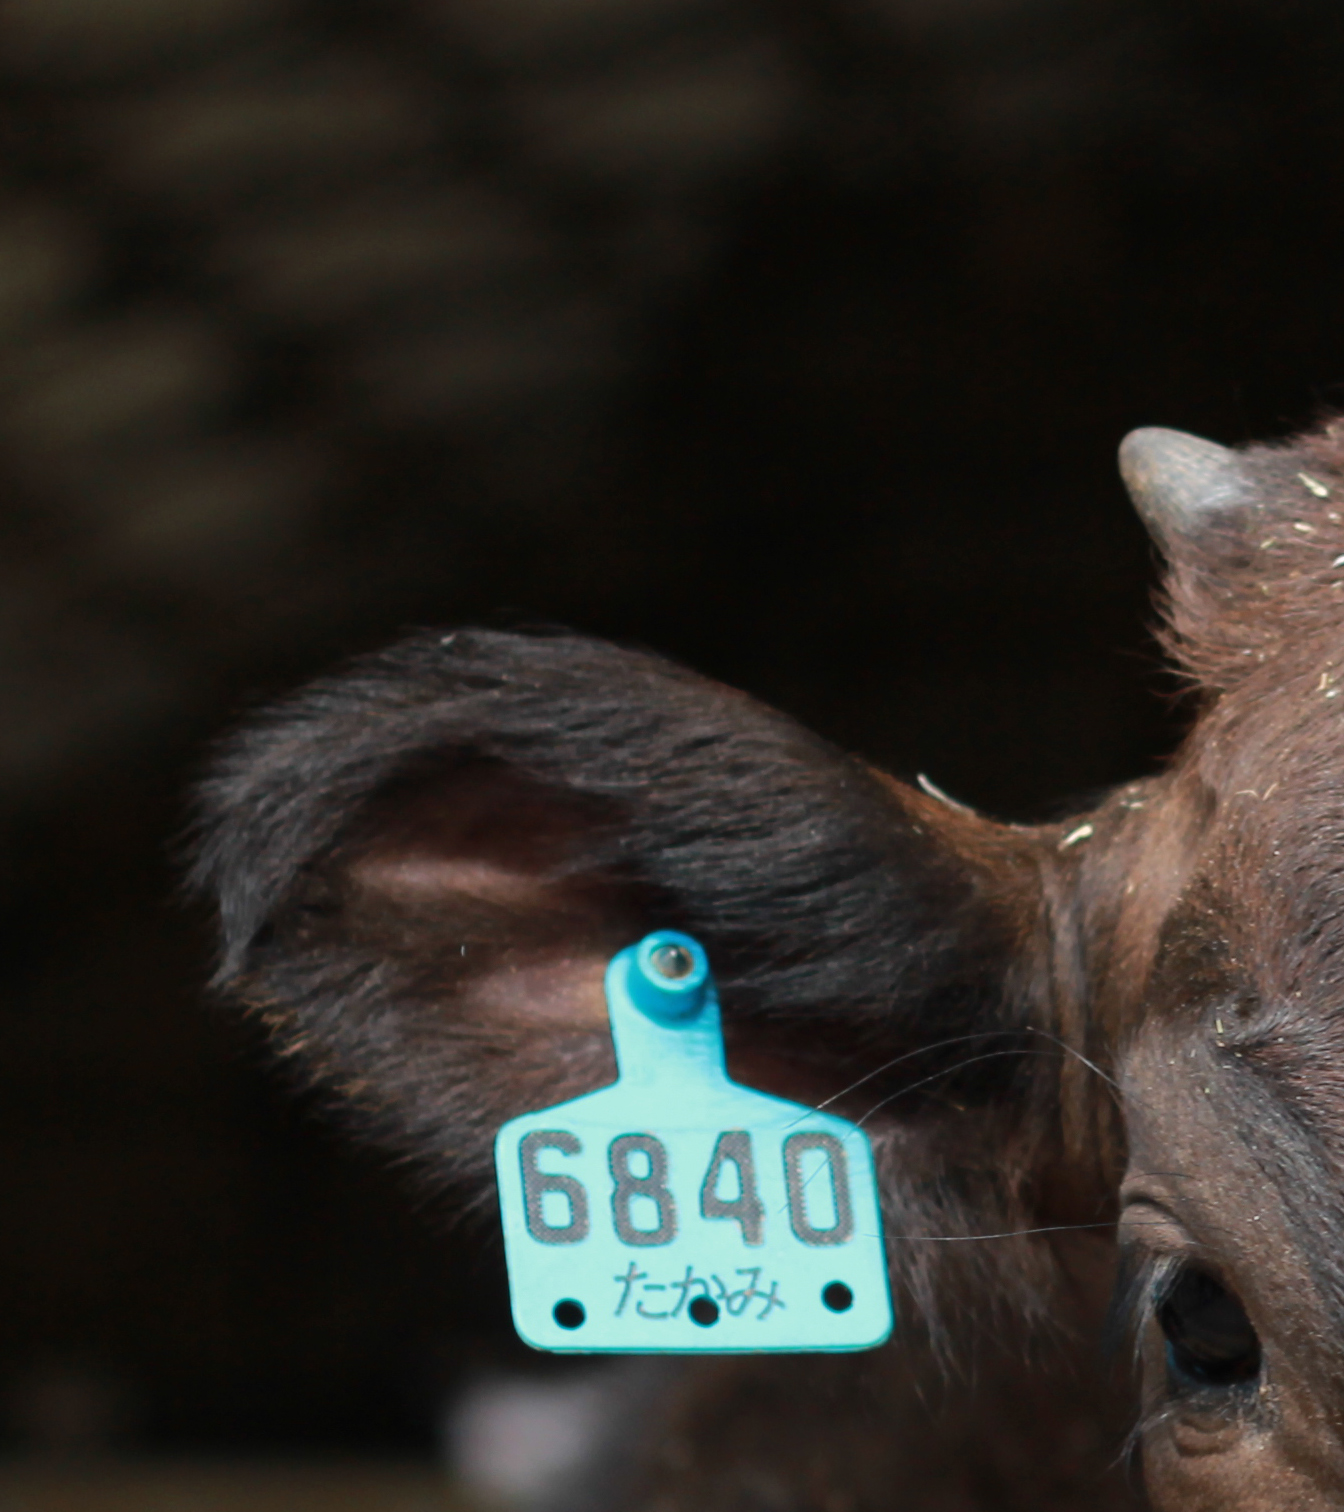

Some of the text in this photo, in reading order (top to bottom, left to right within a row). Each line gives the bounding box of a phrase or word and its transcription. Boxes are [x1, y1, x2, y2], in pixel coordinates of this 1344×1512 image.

[518, 1127, 856, 1248] 6840
[614, 1261, 786, 1320] たかみ
